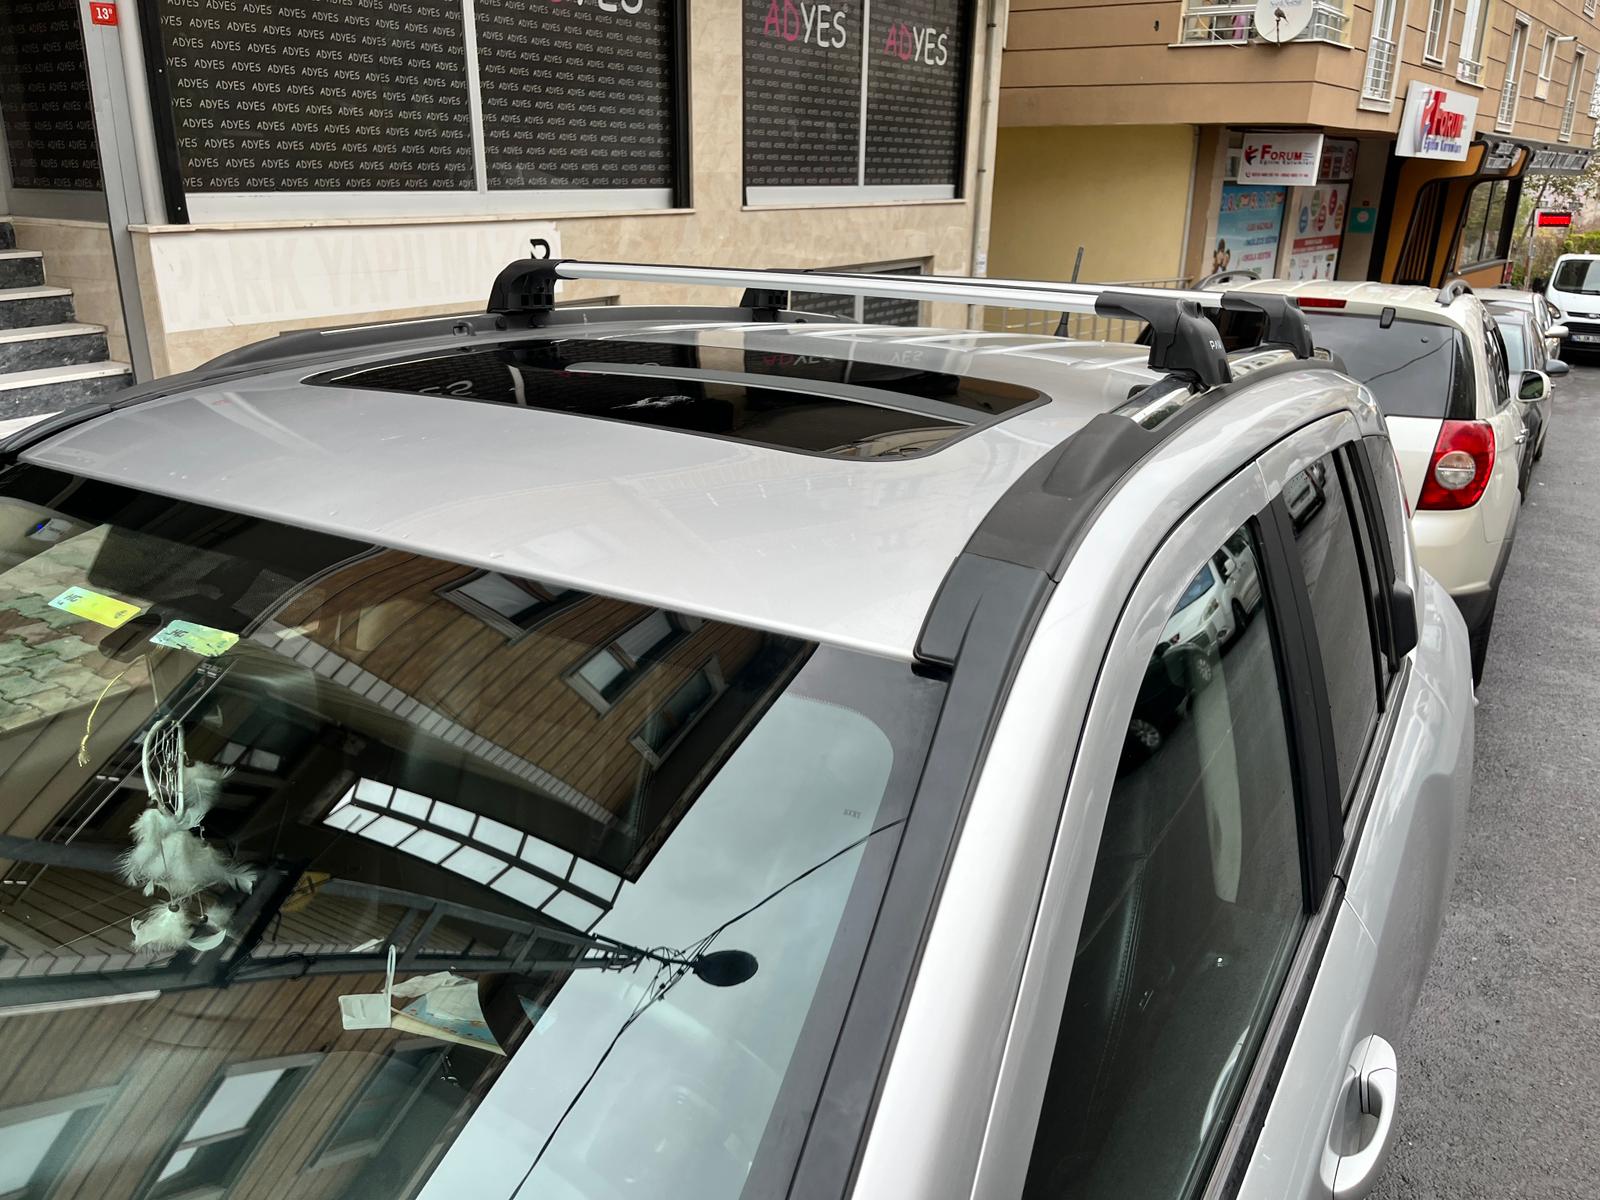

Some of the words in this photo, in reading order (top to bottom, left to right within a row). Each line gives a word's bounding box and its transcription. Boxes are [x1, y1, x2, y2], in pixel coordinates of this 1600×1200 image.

[206, 0, 236, 11] ADYES
[243, 4, 272, 15] ADYES
[278, 8, 306, 19] ADYES
[312, 12, 339, 23] ADYES
[345, 16, 370, 26] ADYES
[376, 20, 400, 30] ADYES
[405, 23, 428, 33] ADYES
[433, 27, 455, 37] ADYES
[358, 0, 383, 10] ADYES
[388, 3, 412, 14] ADYES
[418, 7, 440, 18] ADYES
[190, 18, 220, 30] ADYES
[227, 22, 257, 33] ADYES
[263, 26, 292, 36] ADYES
[298, 29, 325, 40] ADYES
[330, 32, 356, 43] ADYES
[362, 36, 387, 46] ADYES
[392, 40, 416, 50] ADYES
[420, 43, 444, 53] ADYES
[764, 0, 846, 48] ADYES
[173, 37, 204, 48] ADYES
[211, 40, 241, 51] ADYES
[248, 43, 276, 54] ADYES
[283, 47, 310, 57] ADYES
[316, 50, 343, 60] ADYES
[348, 53, 374, 63] ADYES
[379, 56, 403, 66] ADYES
[408, 59, 431, 69] ADYES
[436, 62, 458, 72] ADYES
[883, 23, 948, 66] ADYES
[194, 59, 225, 70] ADYES
[232, 62, 262, 72] ADYES
[268, 64, 295, 75] ADYES
[302, 67, 328, 78] ADYES
[334, 70, 360, 80] ADYES
[365, 73, 390, 83] ADYES
[395, 76, 419, 85] ADYES
[423, 78, 446, 87] ADYES
[178, 78, 209, 88] ADYES
[216, 80, 246, 91] ADYES
[252, 83, 281, 93] ADYES
[287, 85, 314, 95] ADYES
[320, 88, 346, 97] ADYES
[352, 90, 378, 100] ADYES
[383, 92, 406, 102] ADYES
[411, 94, 434, 104] ADYES
[439, 96, 461, 106] ADYES
[200, 100, 230, 110] ADYES
[237, 101, 266, 111] ADYES
[272, 103, 300, 113] ADYES
[306, 105, 333, 115] ADYES
[338, 107, 364, 117] ADYES
[369, 109, 394, 118] ADYES
[399, 111, 422, 120] ADYES
[426, 112, 449, 122] ADYES
[183, 118, 214, 128] ADYES
[221, 120, 250, 130] ADYES
[257, 121, 286, 131] ADYES
[291, 123, 319, 133] ADYES
[324, 124, 350, 134] ADYES
[356, 126, 381, 136] ADYES
[386, 128, 410, 136] ADYES
[414, 129, 438, 138] ADYES
[441, 130, 465, 139] ADYES
[205, 139, 235, 149] ADYES
[242, 140, 270, 150] ADYES
[277, 141, 304, 150] ADYES
[310, 142, 336, 152] ADYES
[342, 144, 368, 152] ADYES
[373, 144, 397, 153] ADYES
[402, 145, 425, 154] ADYES
[430, 146, 452, 155] ADYES
[1261, 144, 1302, 160] FORUM
[188, 158, 219, 168] ADYES
[226, 158, 255, 168] ADYES
[262, 159, 290, 168] ADYES
[296, 160, 323, 169] ADYES
[328, 161, 354, 170] ADYES
[360, 162, 384, 170] ADYES
[389, 162, 413, 171] ADYES
[417, 162, 440, 171] ADYES
[444, 163, 466, 172] ADYES
[210, 178, 240, 188] ADYES
[246, 178, 275, 187] ADYES
[281, 178, 308, 187] ADYES
[314, 178, 341, 188] ADYES
[346, 179, 371, 188] ADYES
[376, 179, 400, 188] ADYES
[405, 179, 428, 188] ADYES
[433, 179, 454, 188] ADYES
